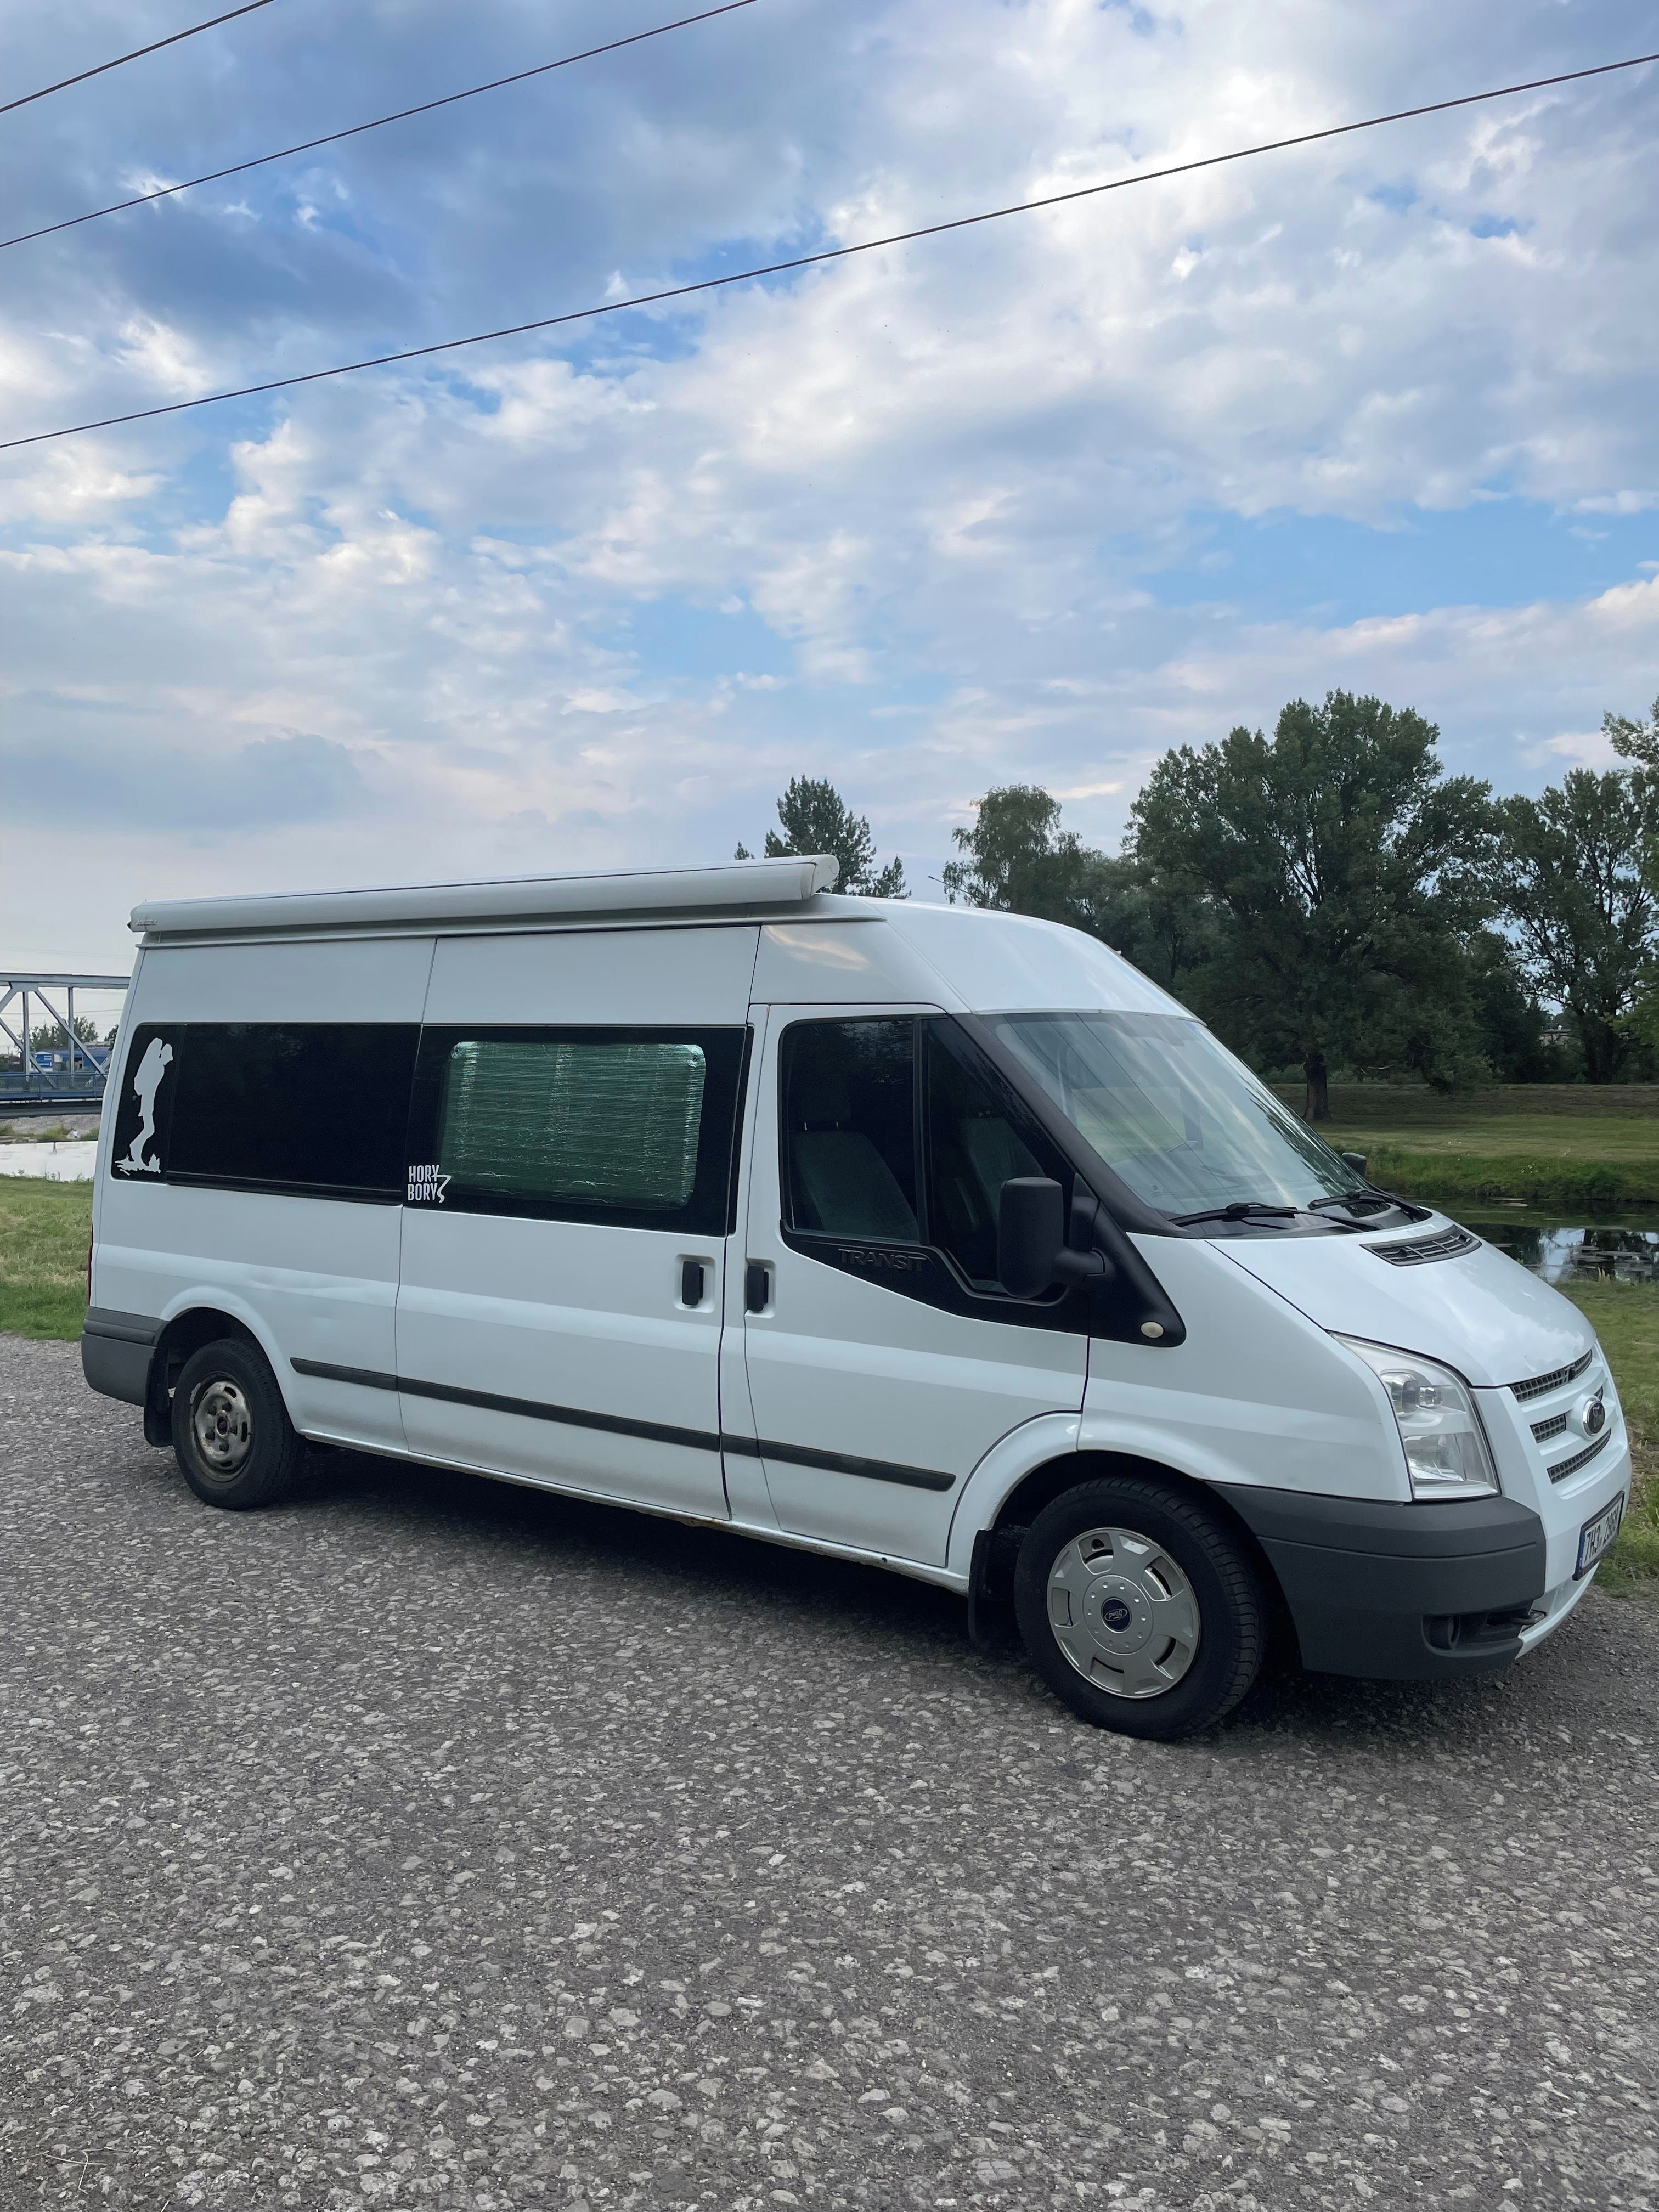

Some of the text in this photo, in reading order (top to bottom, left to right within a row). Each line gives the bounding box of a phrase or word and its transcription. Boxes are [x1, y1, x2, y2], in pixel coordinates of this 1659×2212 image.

[409, 1165, 440, 1183] HORY
[408, 1183, 438, 1201] BORY
[838, 1249, 927, 1272] TRANSIT
